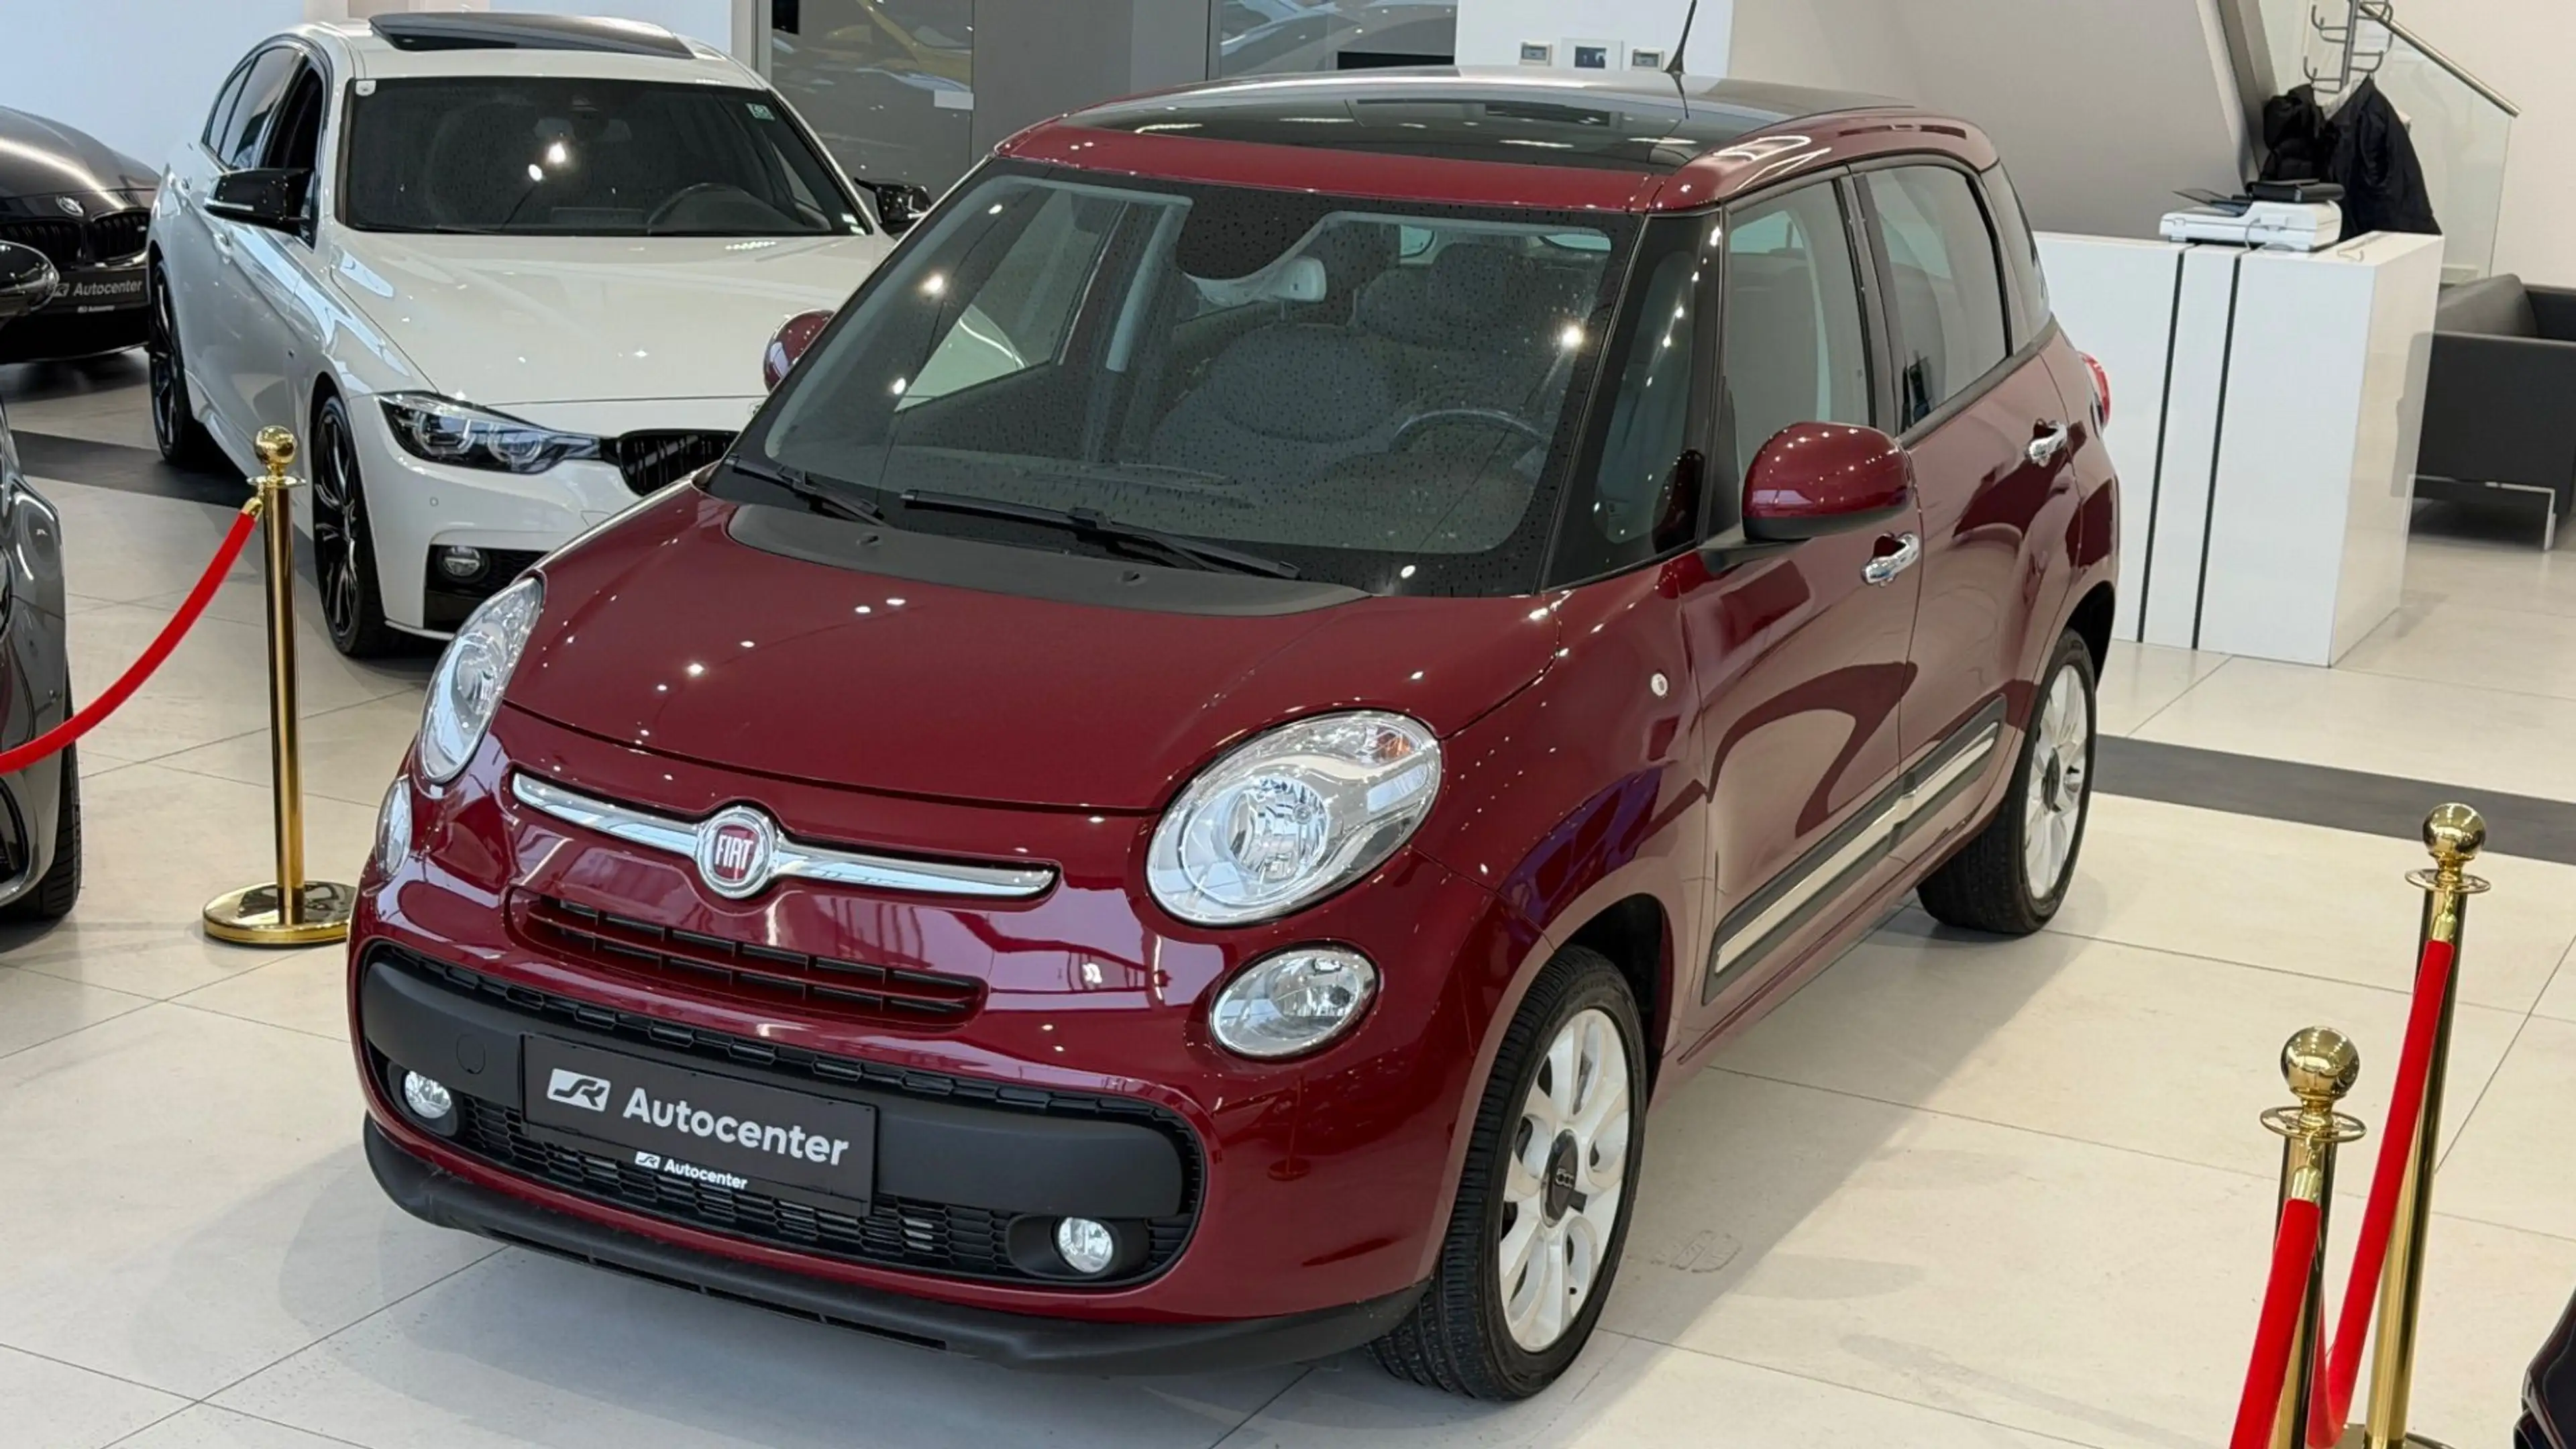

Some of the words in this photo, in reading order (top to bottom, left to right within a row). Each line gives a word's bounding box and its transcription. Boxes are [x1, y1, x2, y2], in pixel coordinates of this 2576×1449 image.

[73, 280, 143, 297] Autocenter
[714, 834, 754, 870] FIAT
[623, 1087, 849, 1166] Autocenter
[663, 1159, 748, 1190] Autocenter
